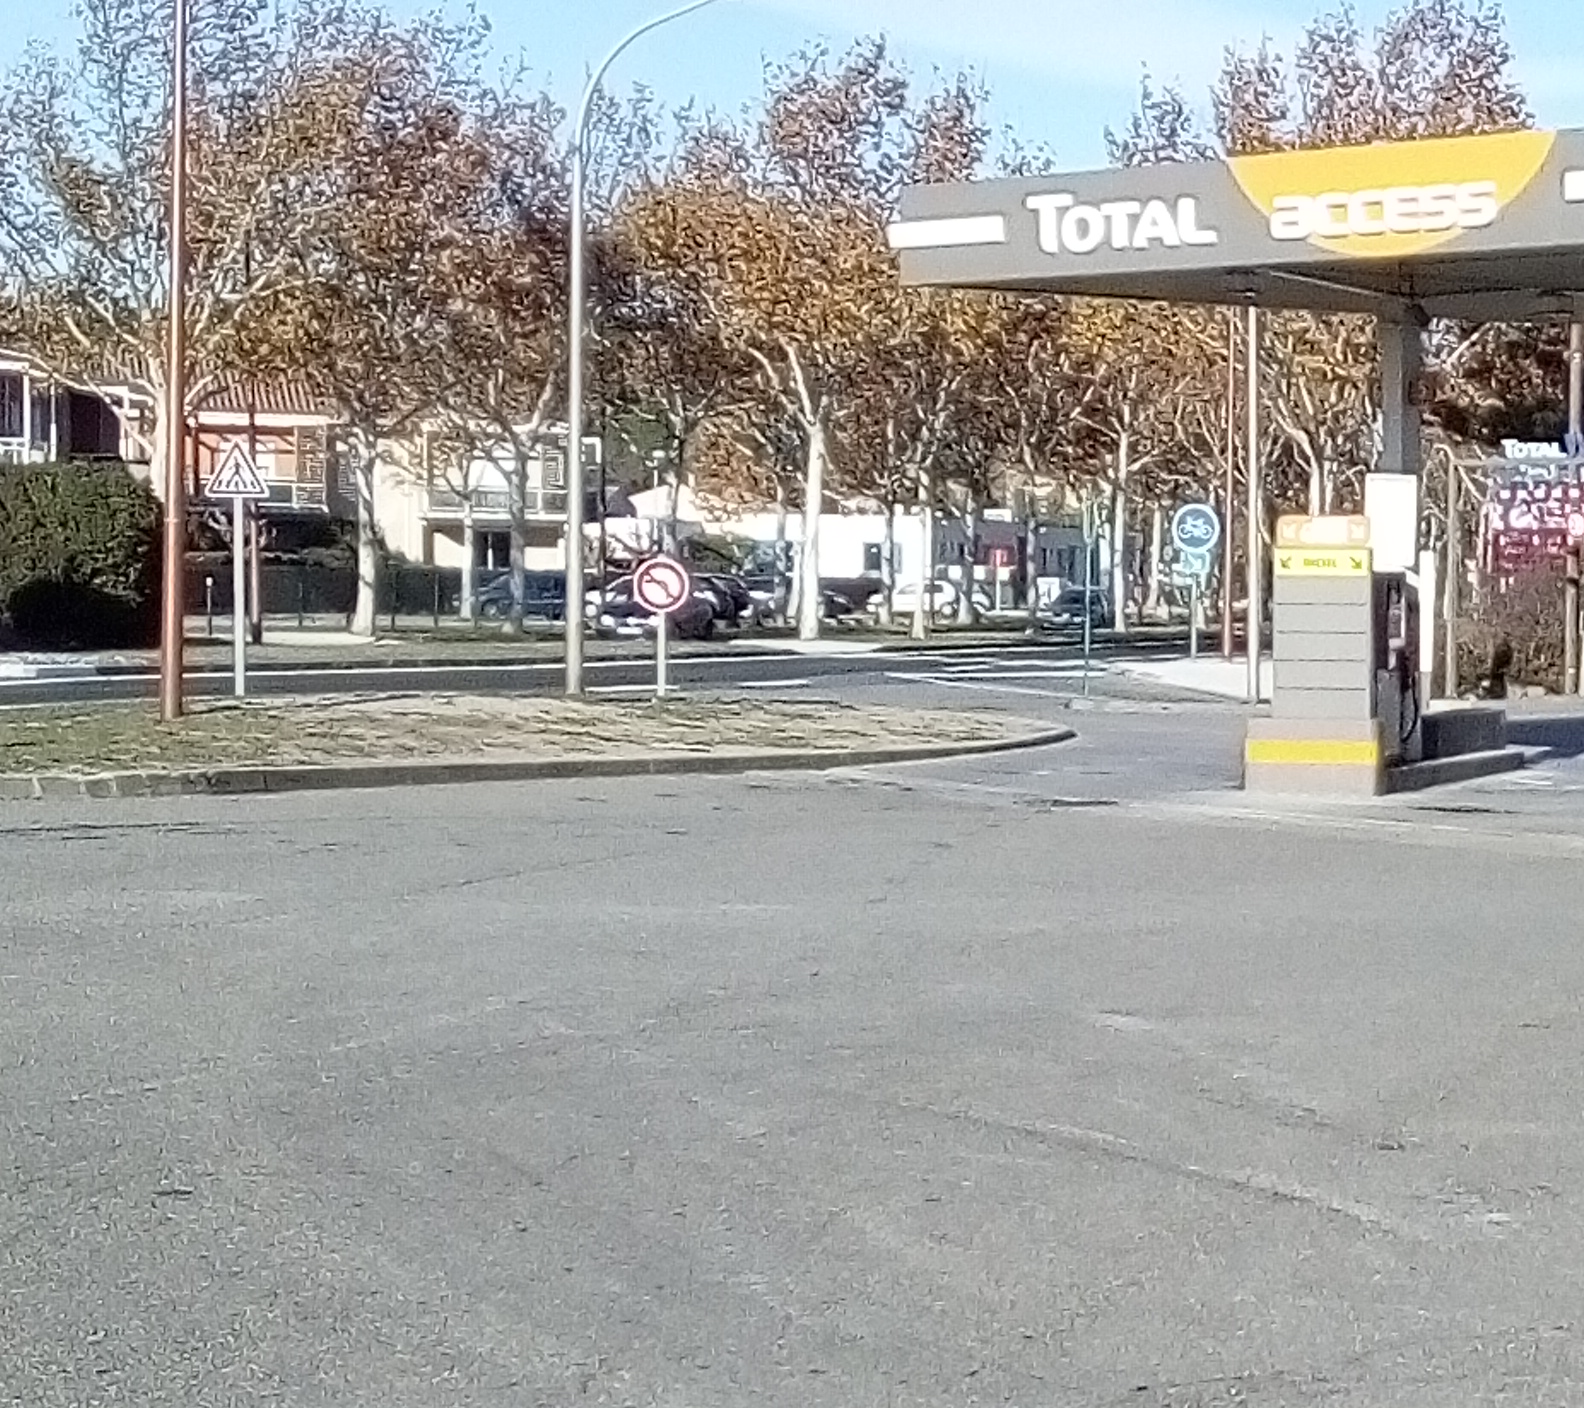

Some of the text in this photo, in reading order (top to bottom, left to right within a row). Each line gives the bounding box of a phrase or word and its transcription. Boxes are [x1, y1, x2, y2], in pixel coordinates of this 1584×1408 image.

[1026, 180, 1498, 254] TOTAL access
[1501, 438, 1567, 459] TOTAL
